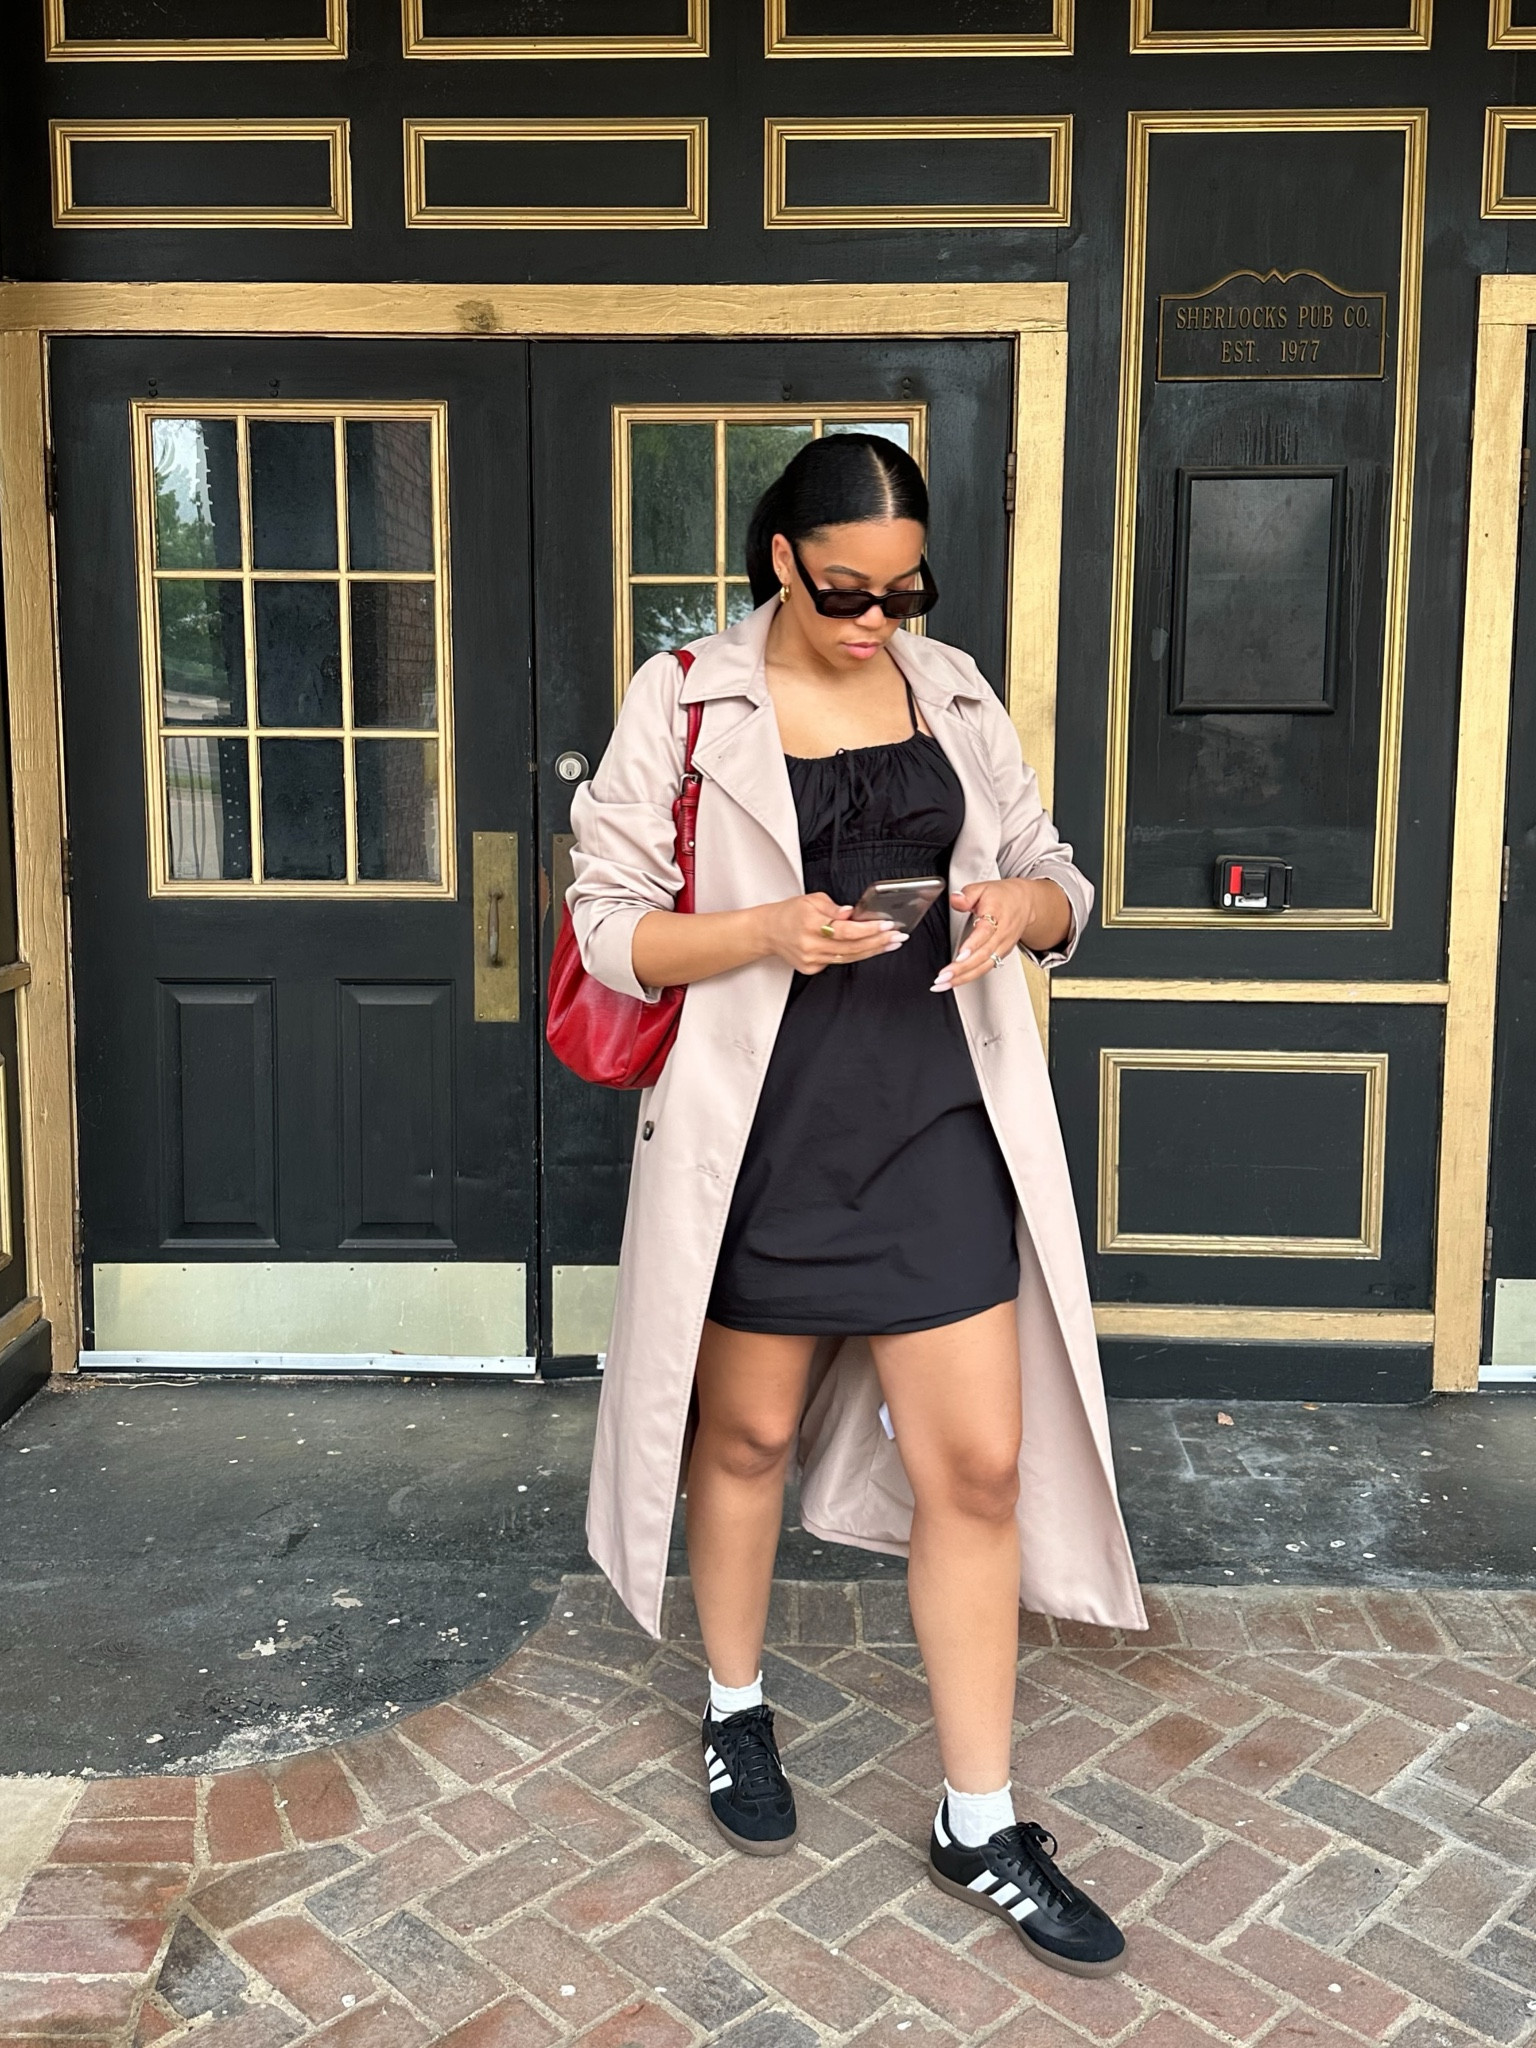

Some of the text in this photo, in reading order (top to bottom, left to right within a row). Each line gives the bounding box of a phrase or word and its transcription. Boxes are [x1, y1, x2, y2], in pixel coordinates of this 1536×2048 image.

[1176, 305, 1371, 329] SHERLOCKS PUB CO.
[1221, 340, 1320, 363] EST. 1977
